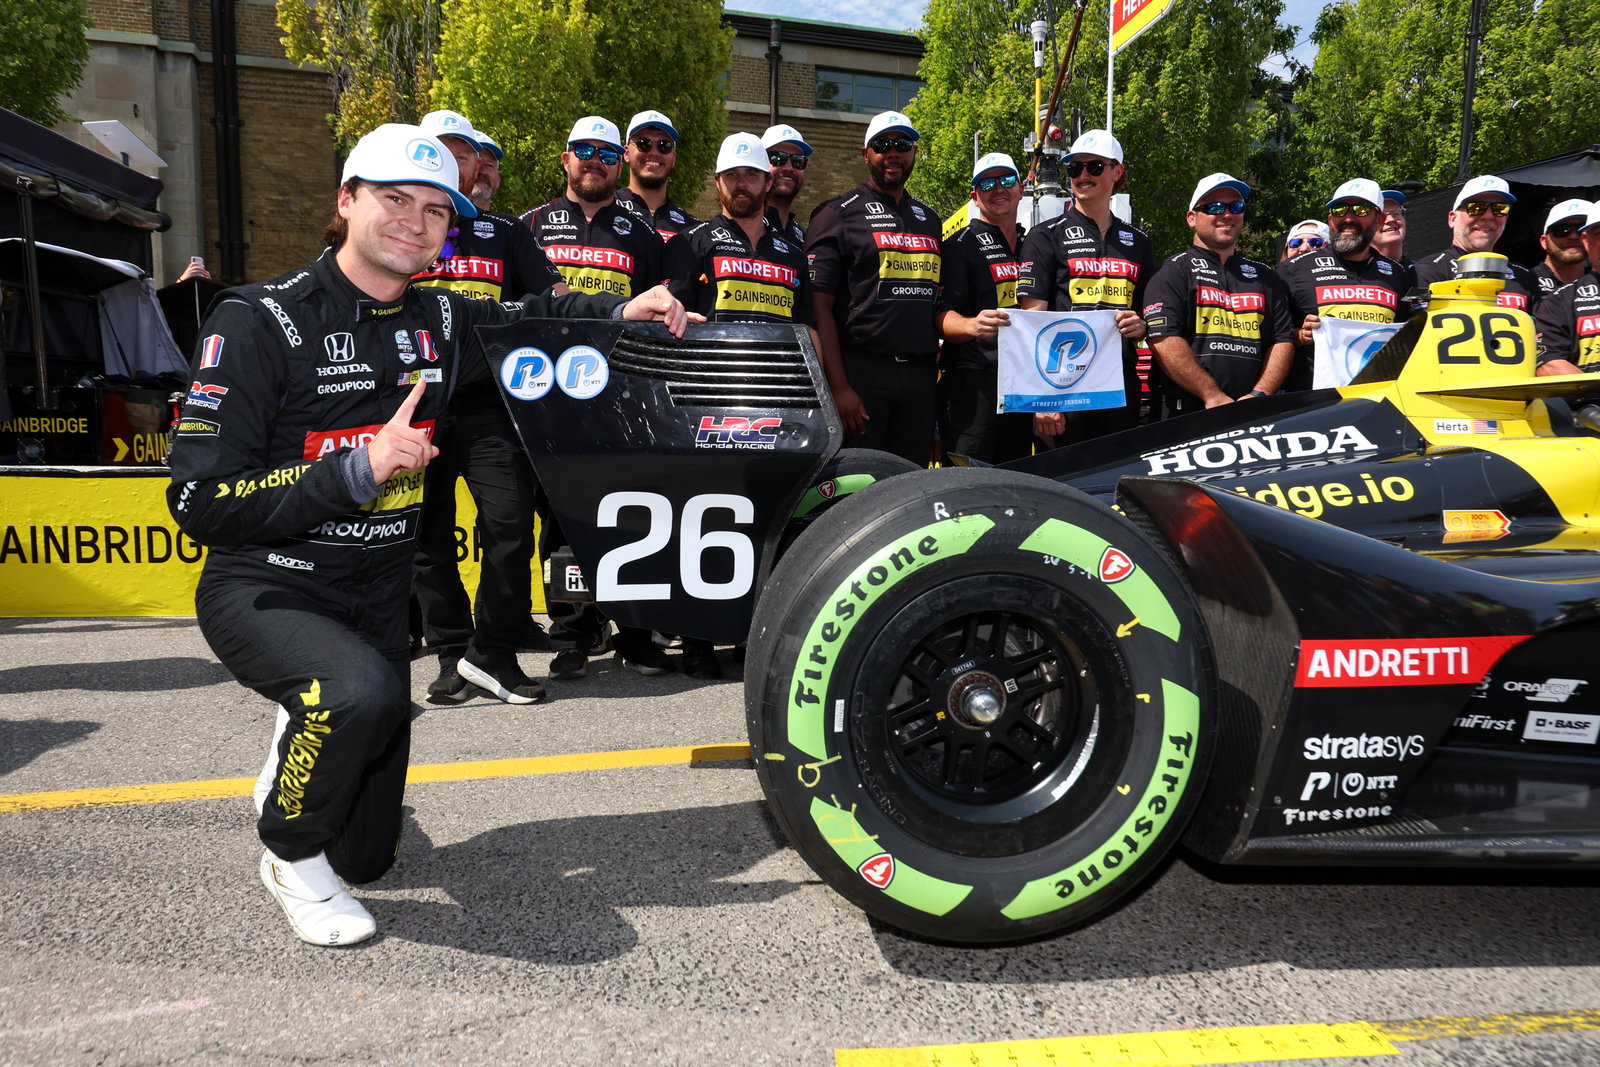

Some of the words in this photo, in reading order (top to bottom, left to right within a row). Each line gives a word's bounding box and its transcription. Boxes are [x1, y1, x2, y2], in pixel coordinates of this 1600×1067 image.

[881, 235, 938, 250] ANDRETTI
[434, 258, 499, 277] DRETTI
[546, 247, 630, 269] ANDRETTI
[893, 260, 939, 274] GAINBRIDE
[720, 259, 794, 283] ANDRETTI
[1074, 260, 1138, 278] ANDRETTI
[734, 289, 792, 308] GAINBRIDGE
[1200, 289, 1263, 308] ANDRETTI
[1322, 288, 1395, 306] ANDRETTI
[261, 297, 302, 347] sparco
[1212, 315, 1260, 331] GAINBRIDG
[1432, 312, 1526, 365] 26
[316, 363, 373, 376] HONDA
[317, 380, 376, 395] GROUP1001
[0, 417, 88, 433] AINBRIDGE
[695, 416, 782, 443] HRC
[1249, 424, 1275, 434] by
[1437, 422, 1468, 432] Herta
[1142, 425, 1378, 476] HONDA
[933, 502, 950, 520] R
[596, 490, 755, 602] 26
[267, 553, 314, 570] sparco
[795, 535, 939, 708] Firestone
[1307, 647, 1469, 678] ANDRETTI
[1555, 720, 1593, 730] BASF
[1303, 732, 1425, 762] stratasys
[1366, 775, 1398, 790] NTT
[1055, 731, 1193, 898] Firestone
[1282, 804, 1392, 826] Firestone
